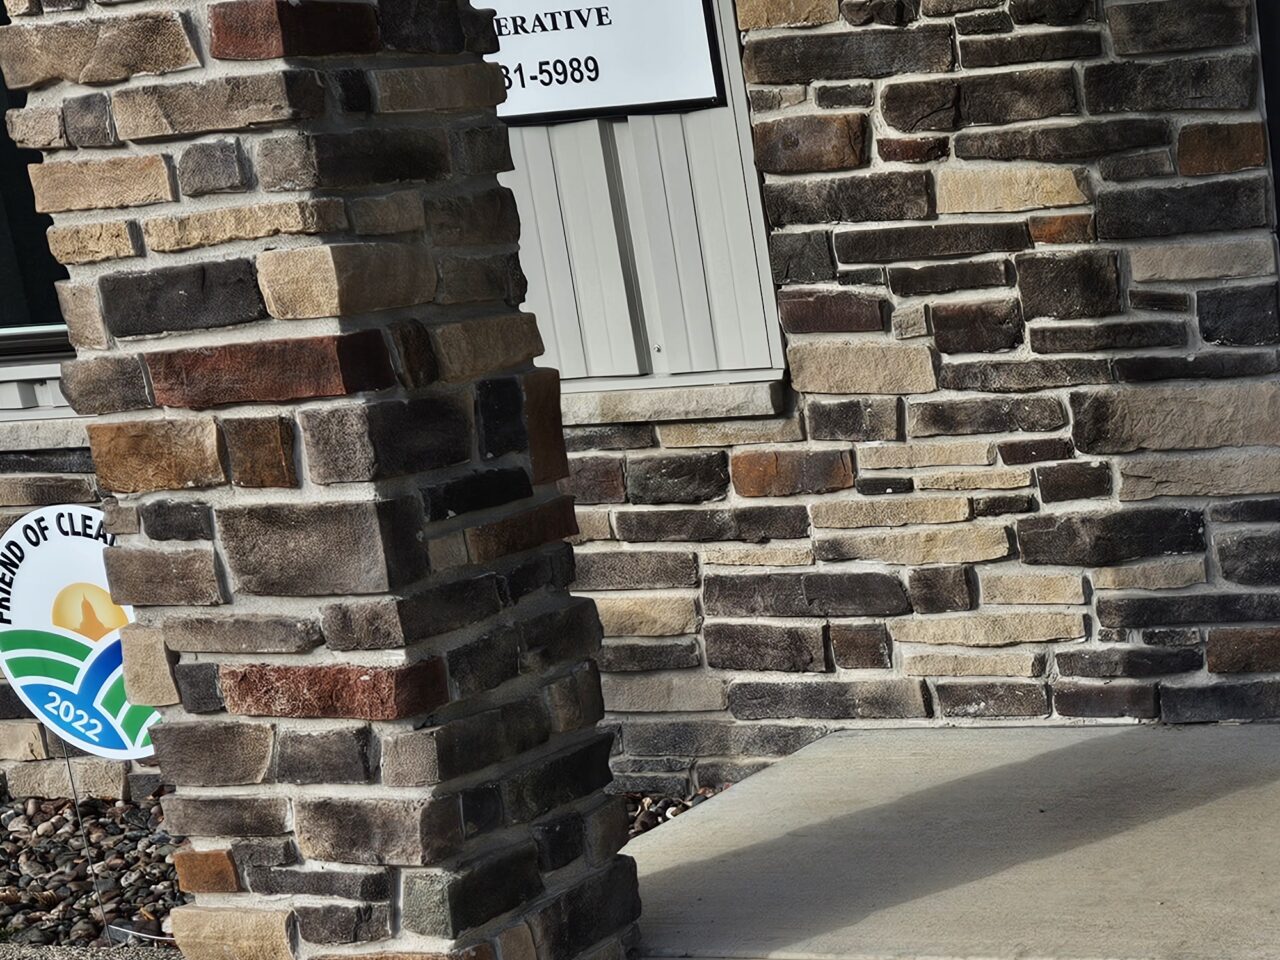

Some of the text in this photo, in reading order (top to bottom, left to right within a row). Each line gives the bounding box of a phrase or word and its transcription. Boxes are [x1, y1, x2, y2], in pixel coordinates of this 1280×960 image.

[494, 6, 613, 36] ERATIVE
[22, 515, 49, 548] OF
[43, 691, 103, 743] 2022
